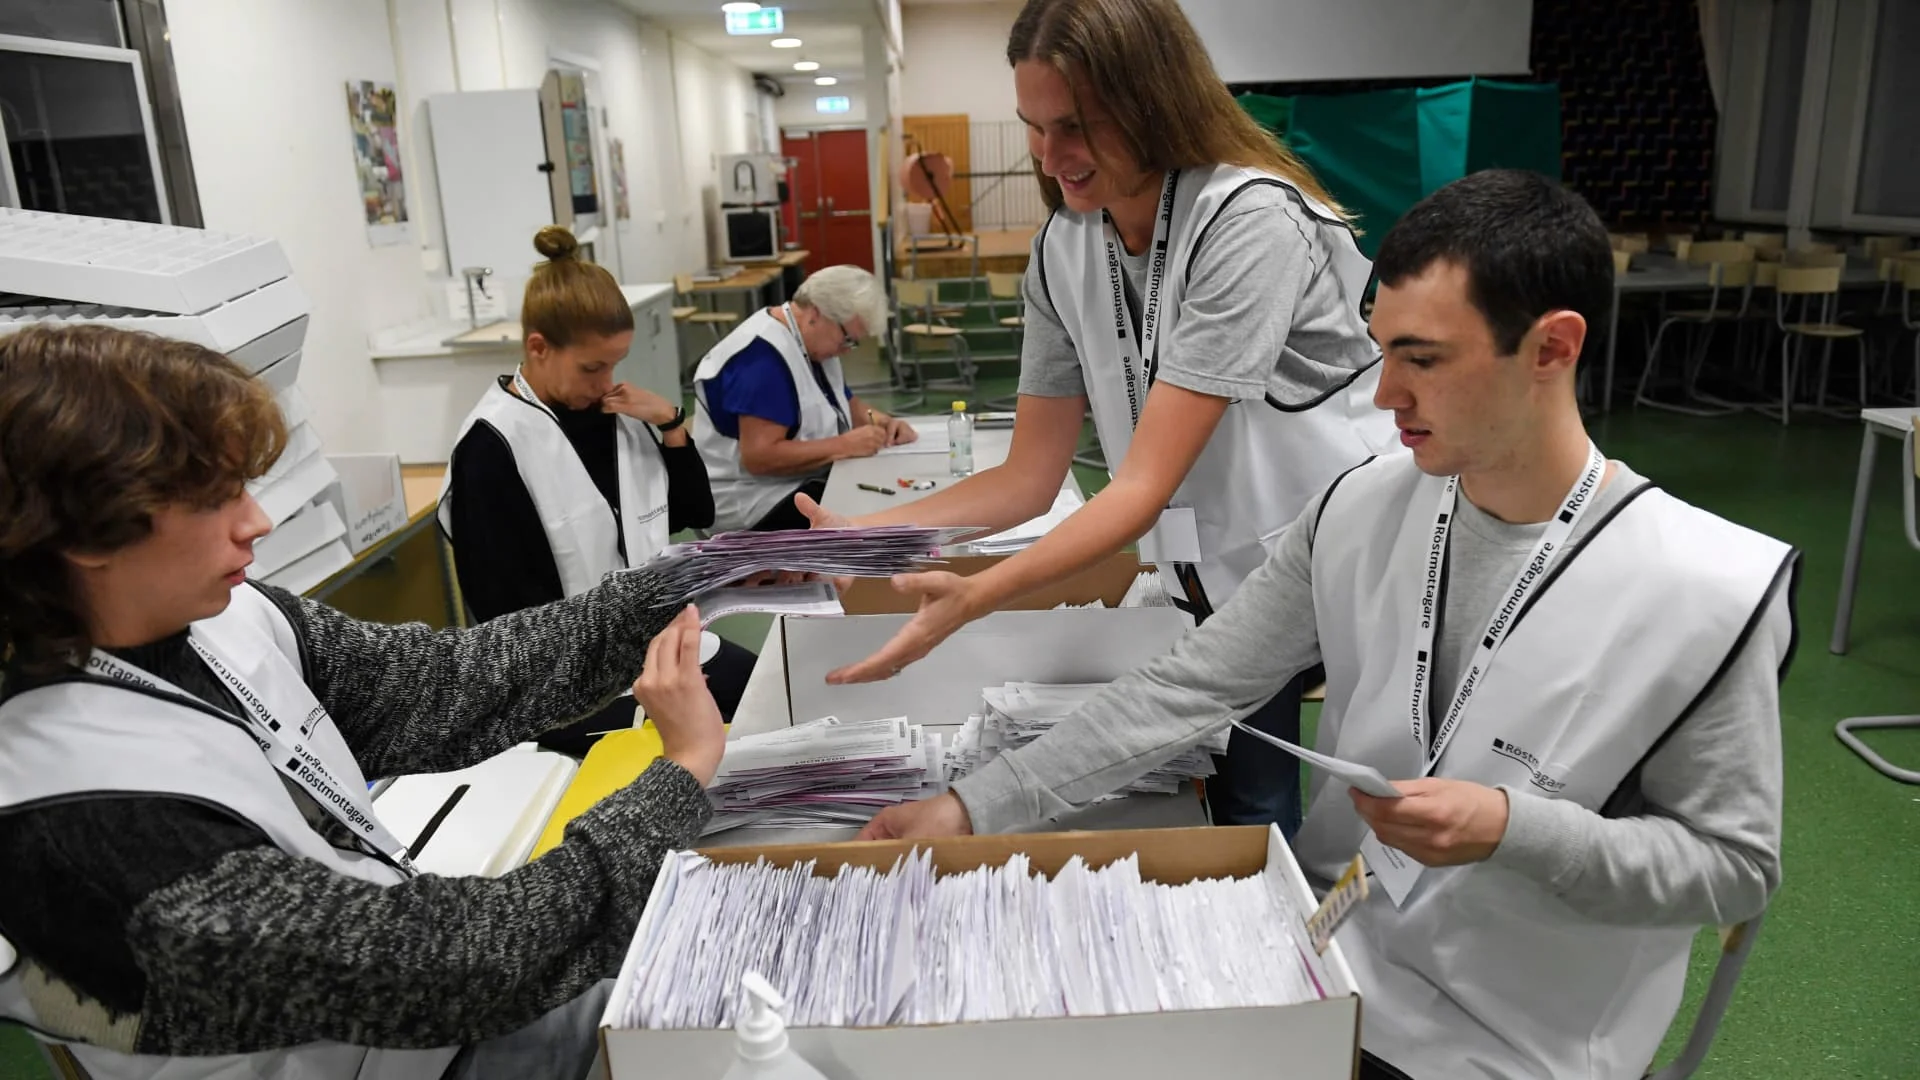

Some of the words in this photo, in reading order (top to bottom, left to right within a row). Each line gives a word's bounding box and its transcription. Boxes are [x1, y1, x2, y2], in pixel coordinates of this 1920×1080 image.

[1107, 242, 1124, 327] Röstmottagare
[1145, 250, 1166, 341] Röstmottagare
[1123, 356, 1139, 432] stmottagare
[1422, 527, 1445, 629] Röstmottagare
[1488, 542, 1554, 637] Röstmottagare
[90, 657, 157, 689] ottagare
[1433, 666, 1479, 752] Röstmottagare
[298, 765, 374, 832] Röstmottagare
